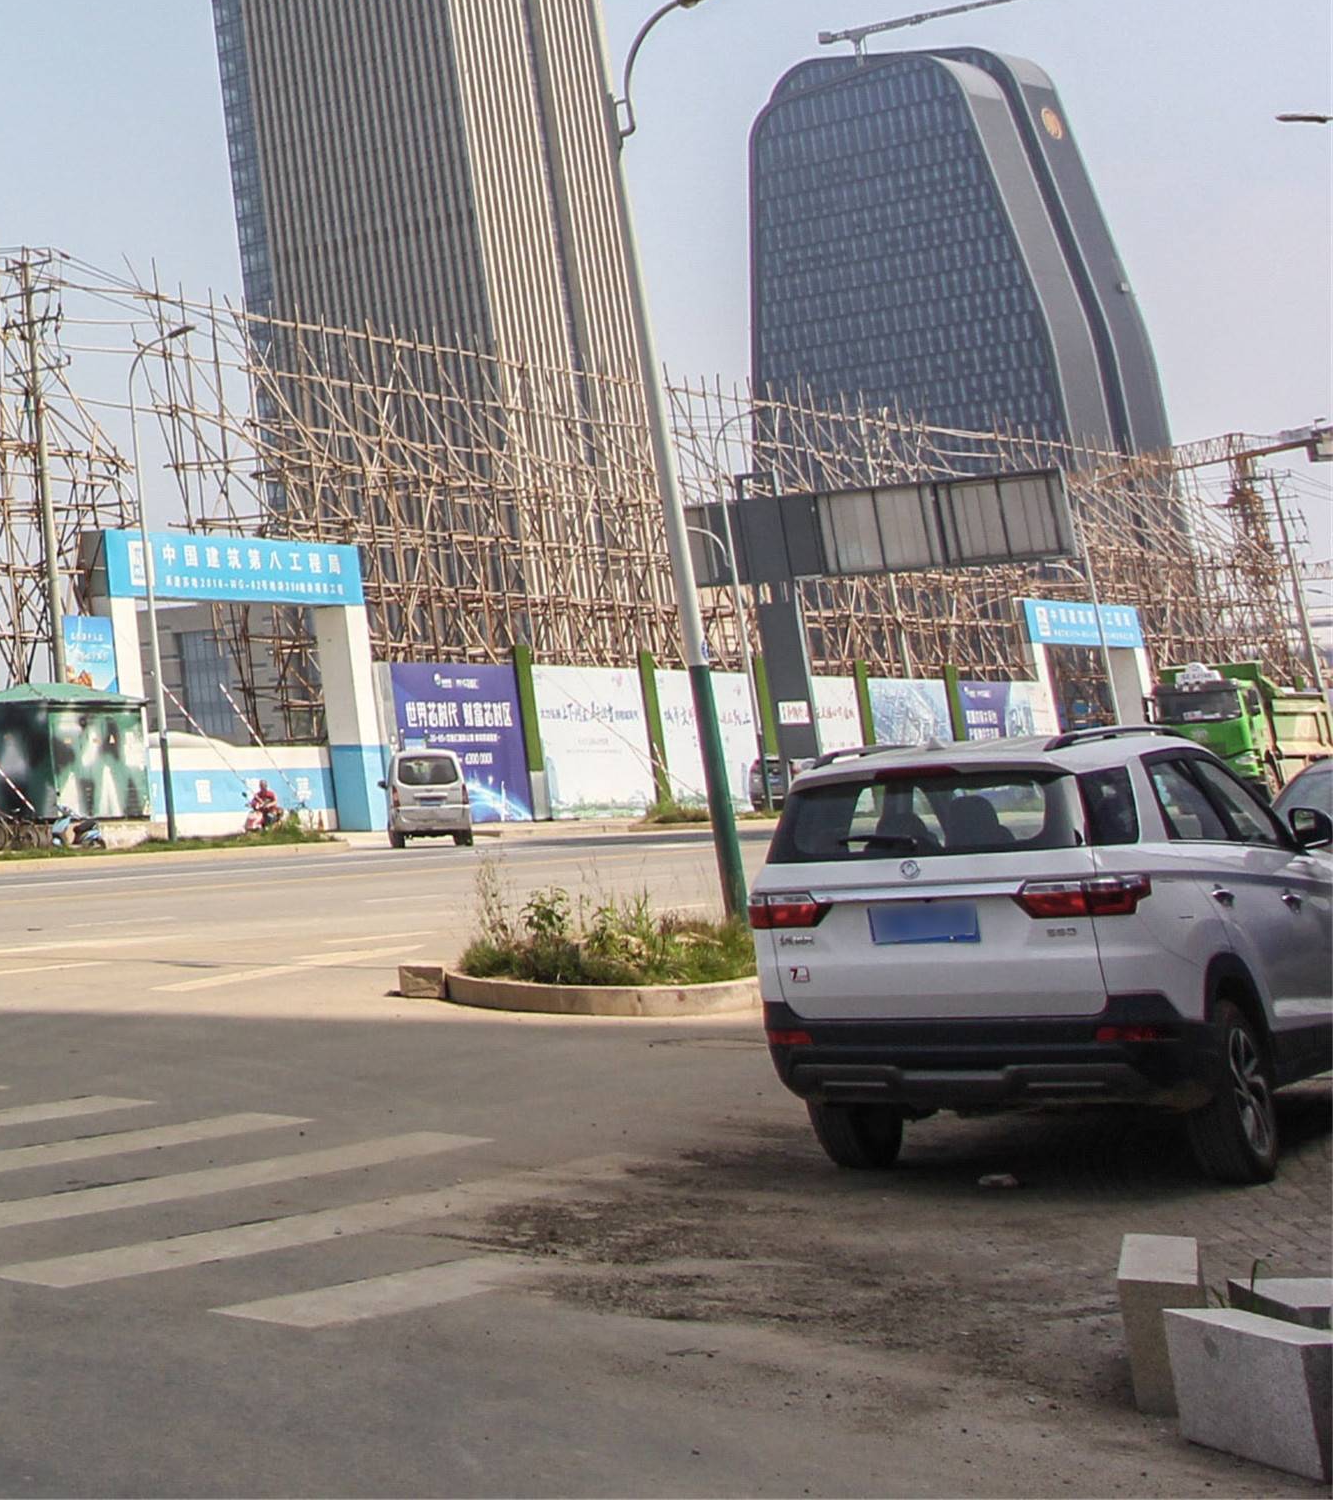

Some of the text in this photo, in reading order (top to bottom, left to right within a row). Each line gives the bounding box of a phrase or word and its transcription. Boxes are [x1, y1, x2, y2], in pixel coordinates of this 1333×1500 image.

[162, 543, 342, 575] 中国建筑第八工程局
